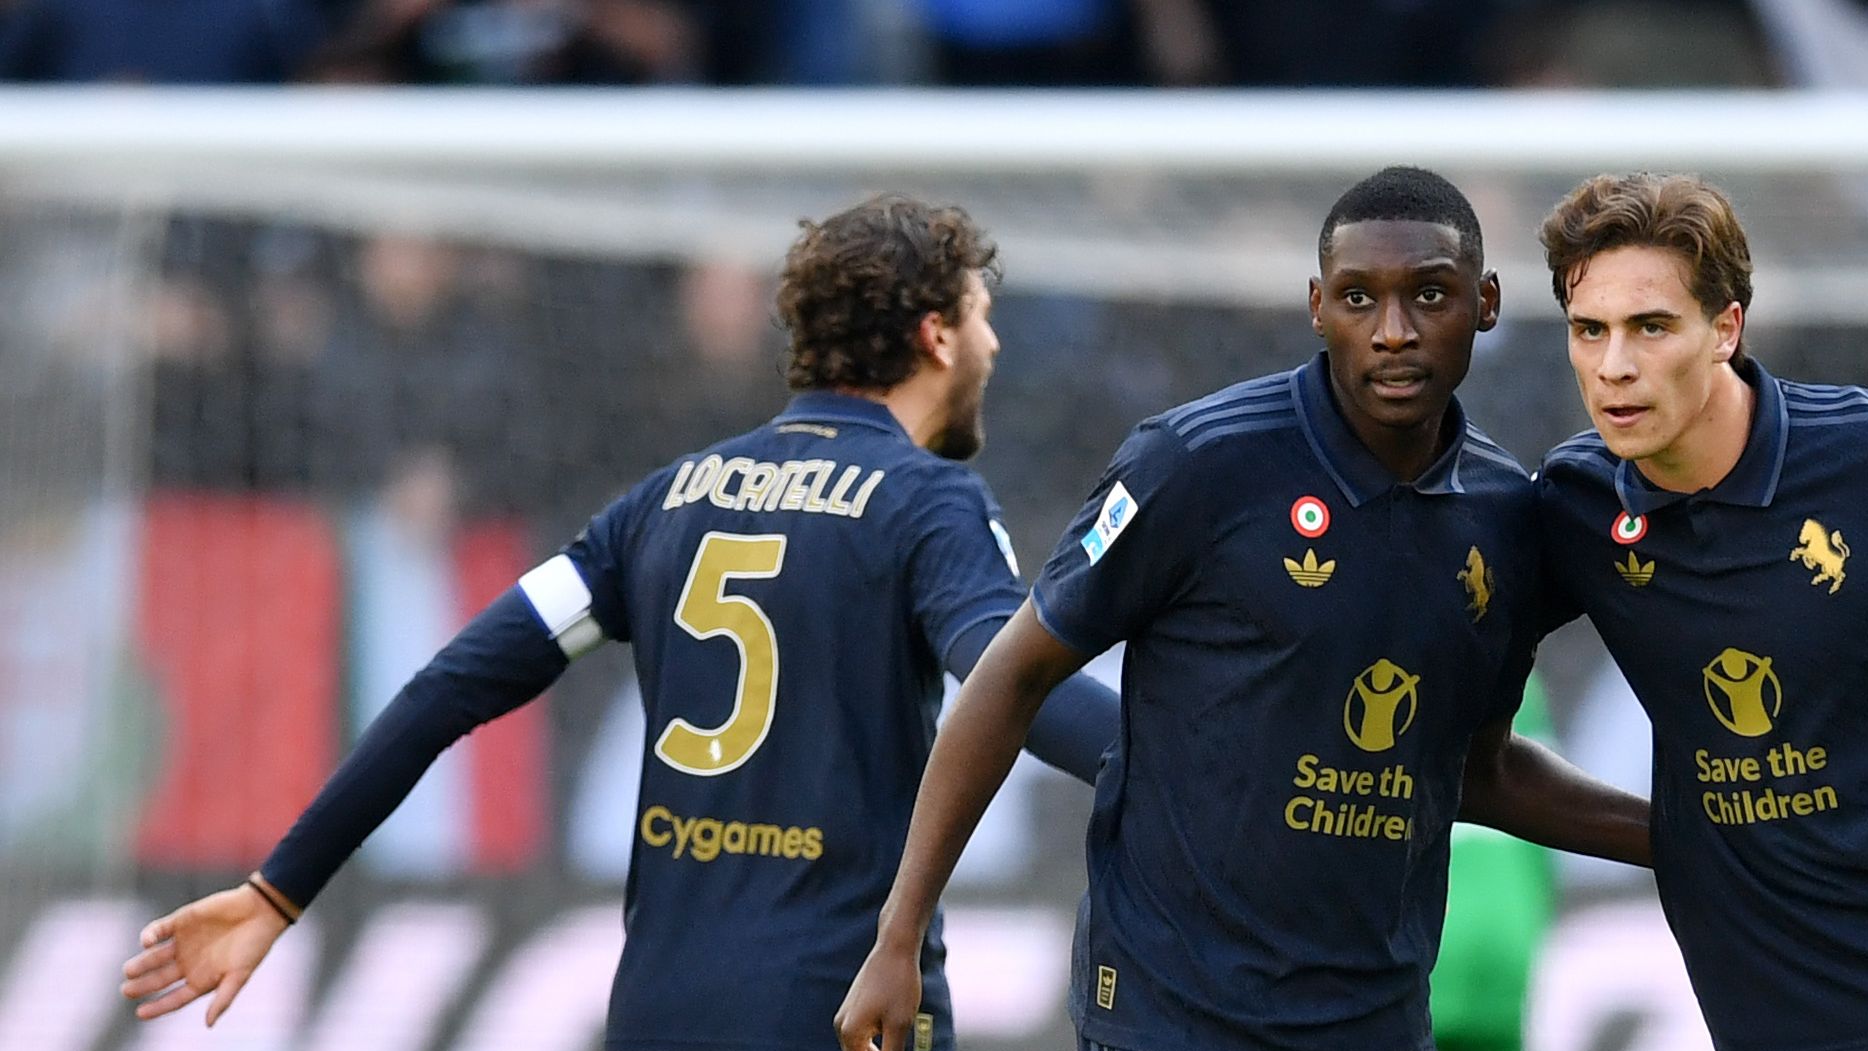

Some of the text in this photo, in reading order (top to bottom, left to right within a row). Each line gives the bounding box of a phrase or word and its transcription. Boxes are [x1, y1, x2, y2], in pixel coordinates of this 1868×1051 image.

[662, 453, 885, 519] LOCATELLI
[654, 531, 788, 777] 5
[1293, 753, 1414, 800] Save th
[1695, 742, 1827, 783] Save the
[1702, 784, 1839, 825] Children
[640, 805, 824, 861] Cygames
